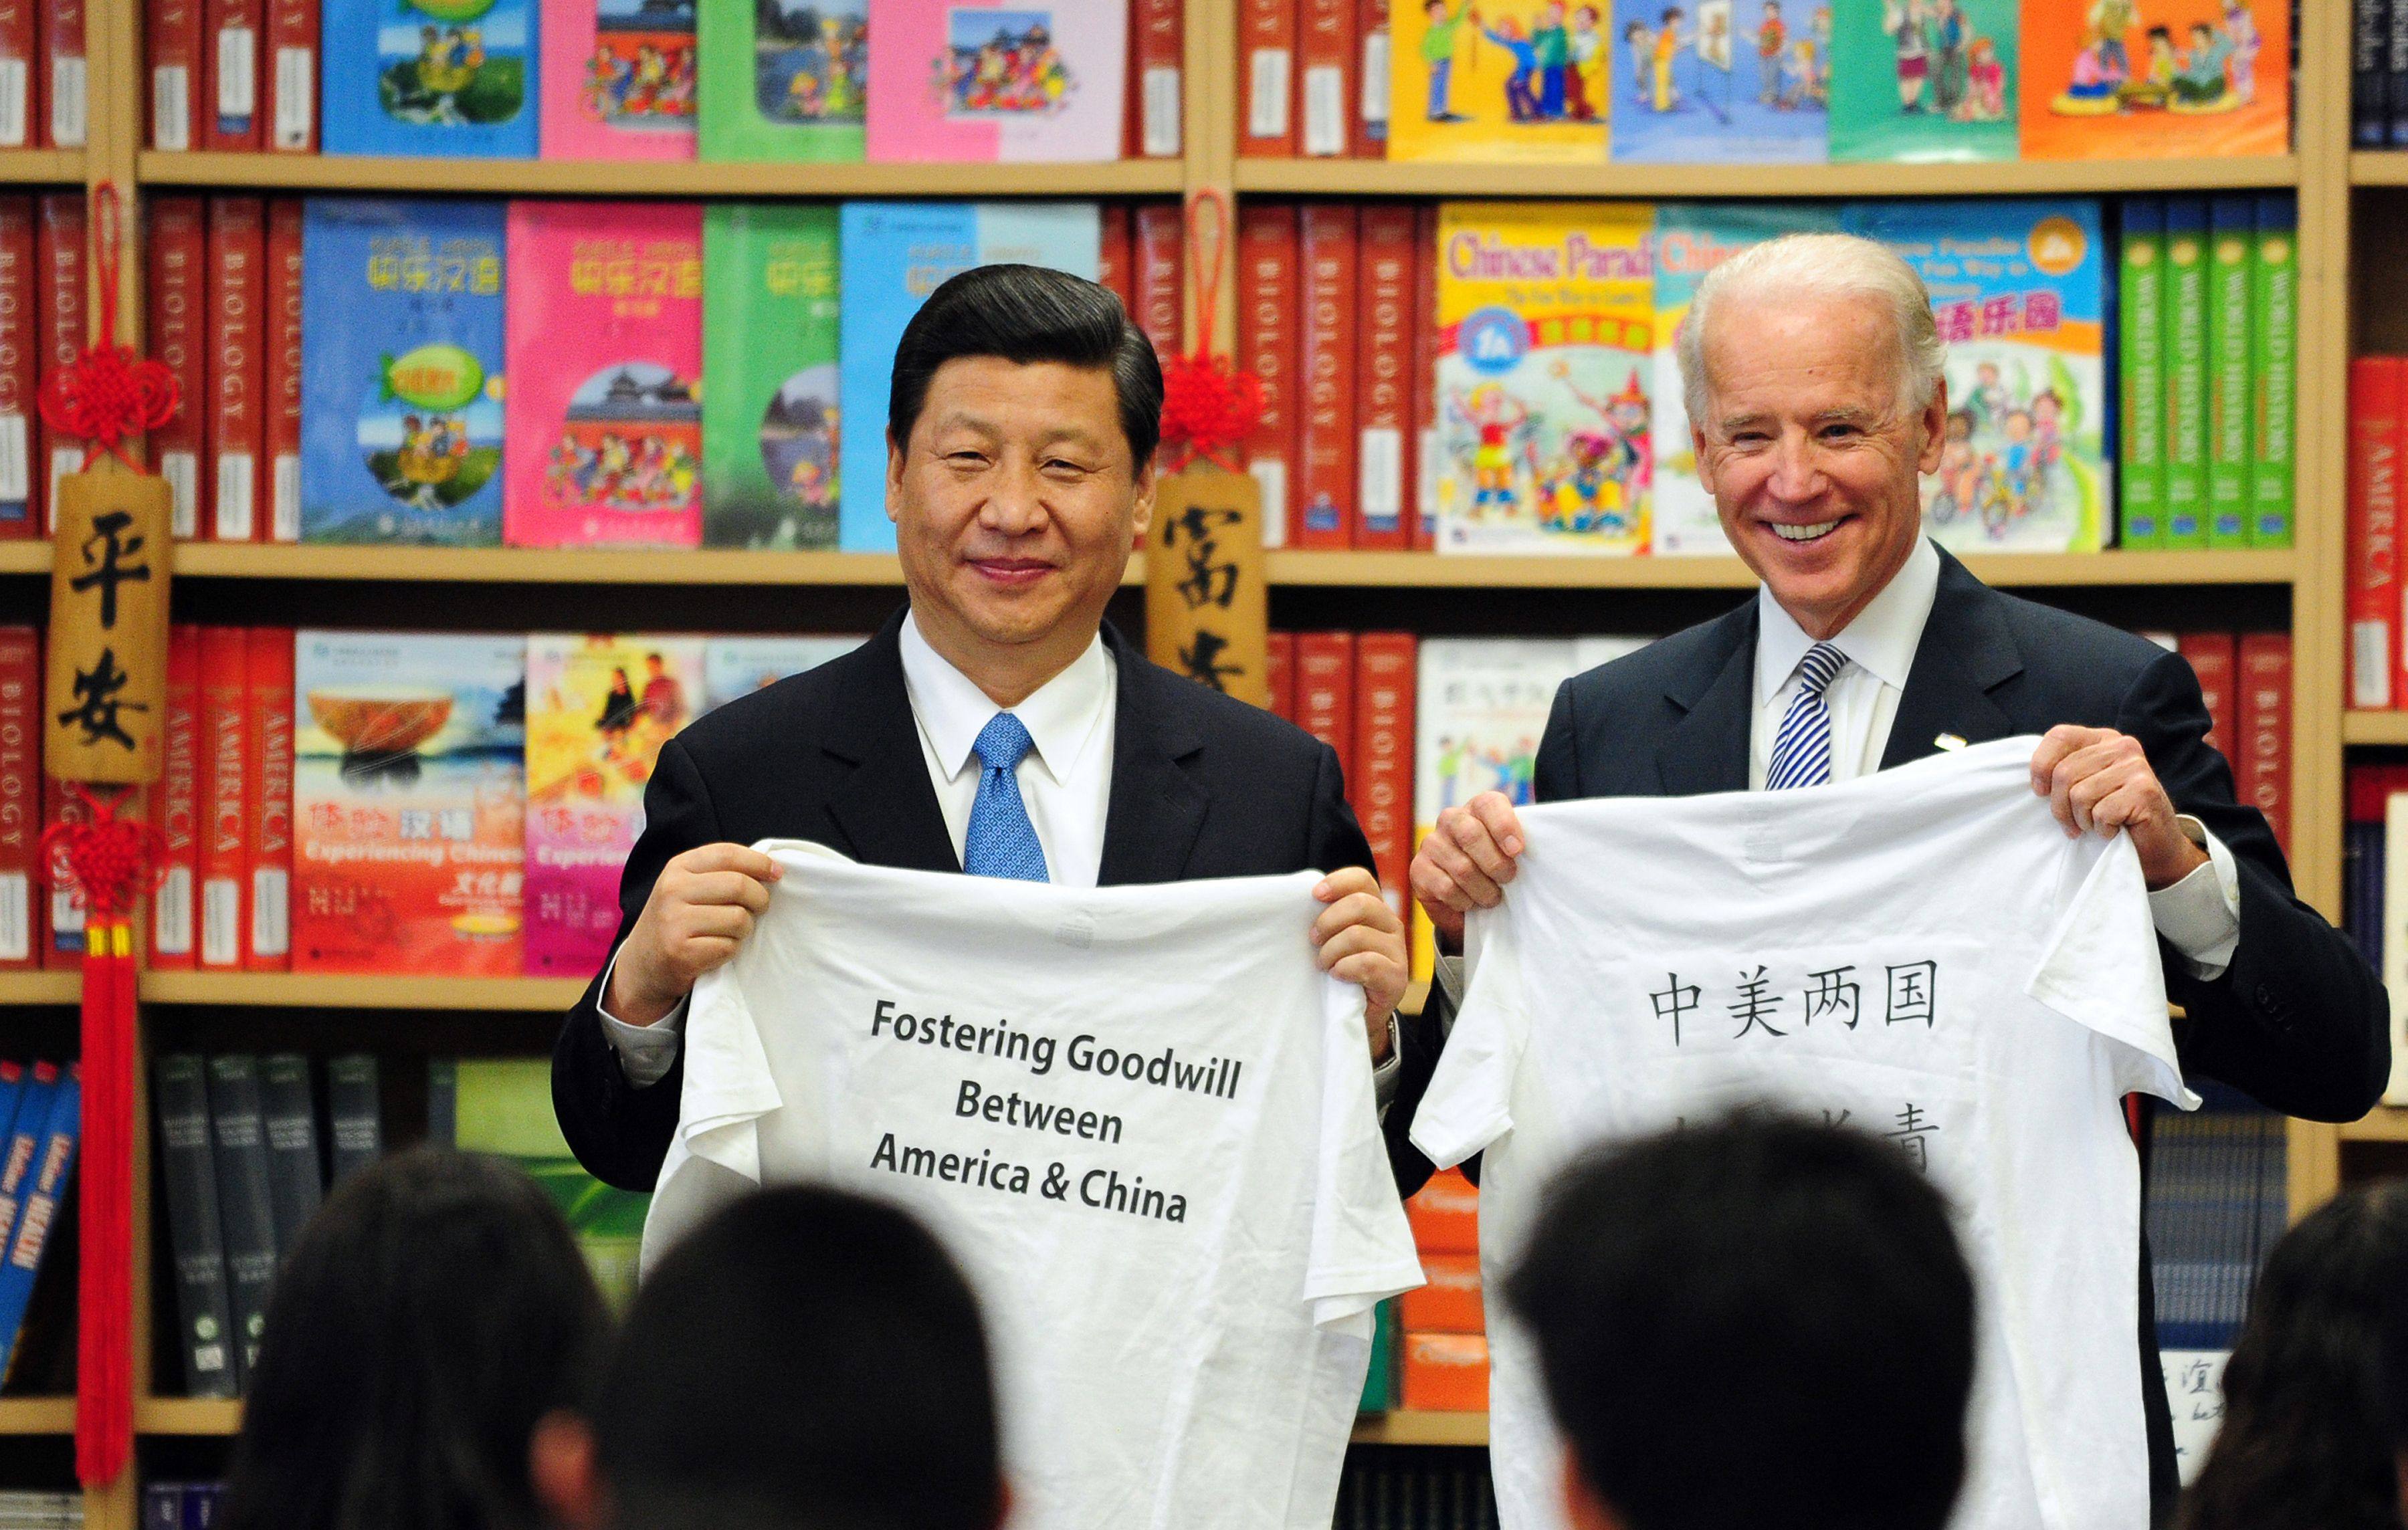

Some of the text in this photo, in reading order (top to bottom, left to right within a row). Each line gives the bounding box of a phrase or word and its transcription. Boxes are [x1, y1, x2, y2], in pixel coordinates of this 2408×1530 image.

[1448, 230, 1655, 280] Chinese Parad
[223, 253, 245, 419] BIOLOGY
[1313, 261, 1338, 427] BIOLOGY
[1373, 263, 1399, 427] BIOLOGY
[2367, 444, 2395, 589] AMERICA
[58, 511, 150, 751] 平安
[2, 683, 22, 847] BIOLOGY
[167, 710, 193, 851] AMERICA
[215, 710, 241, 853] AMERICA
[263, 710, 288, 853] AMERICA
[1369, 691, 1397, 854] BIOLOGY
[2256, 691, 2280, 832] BIOLO
[305, 841, 524, 866] Experiencing Chines
[870, 1000, 1242, 1099] Fostering Goodwill
[1649, 960, 1937, 1047] 中美两国
[870, 1133, 1188, 1223] America & China
[955, 1080, 1123, 1144] Between
